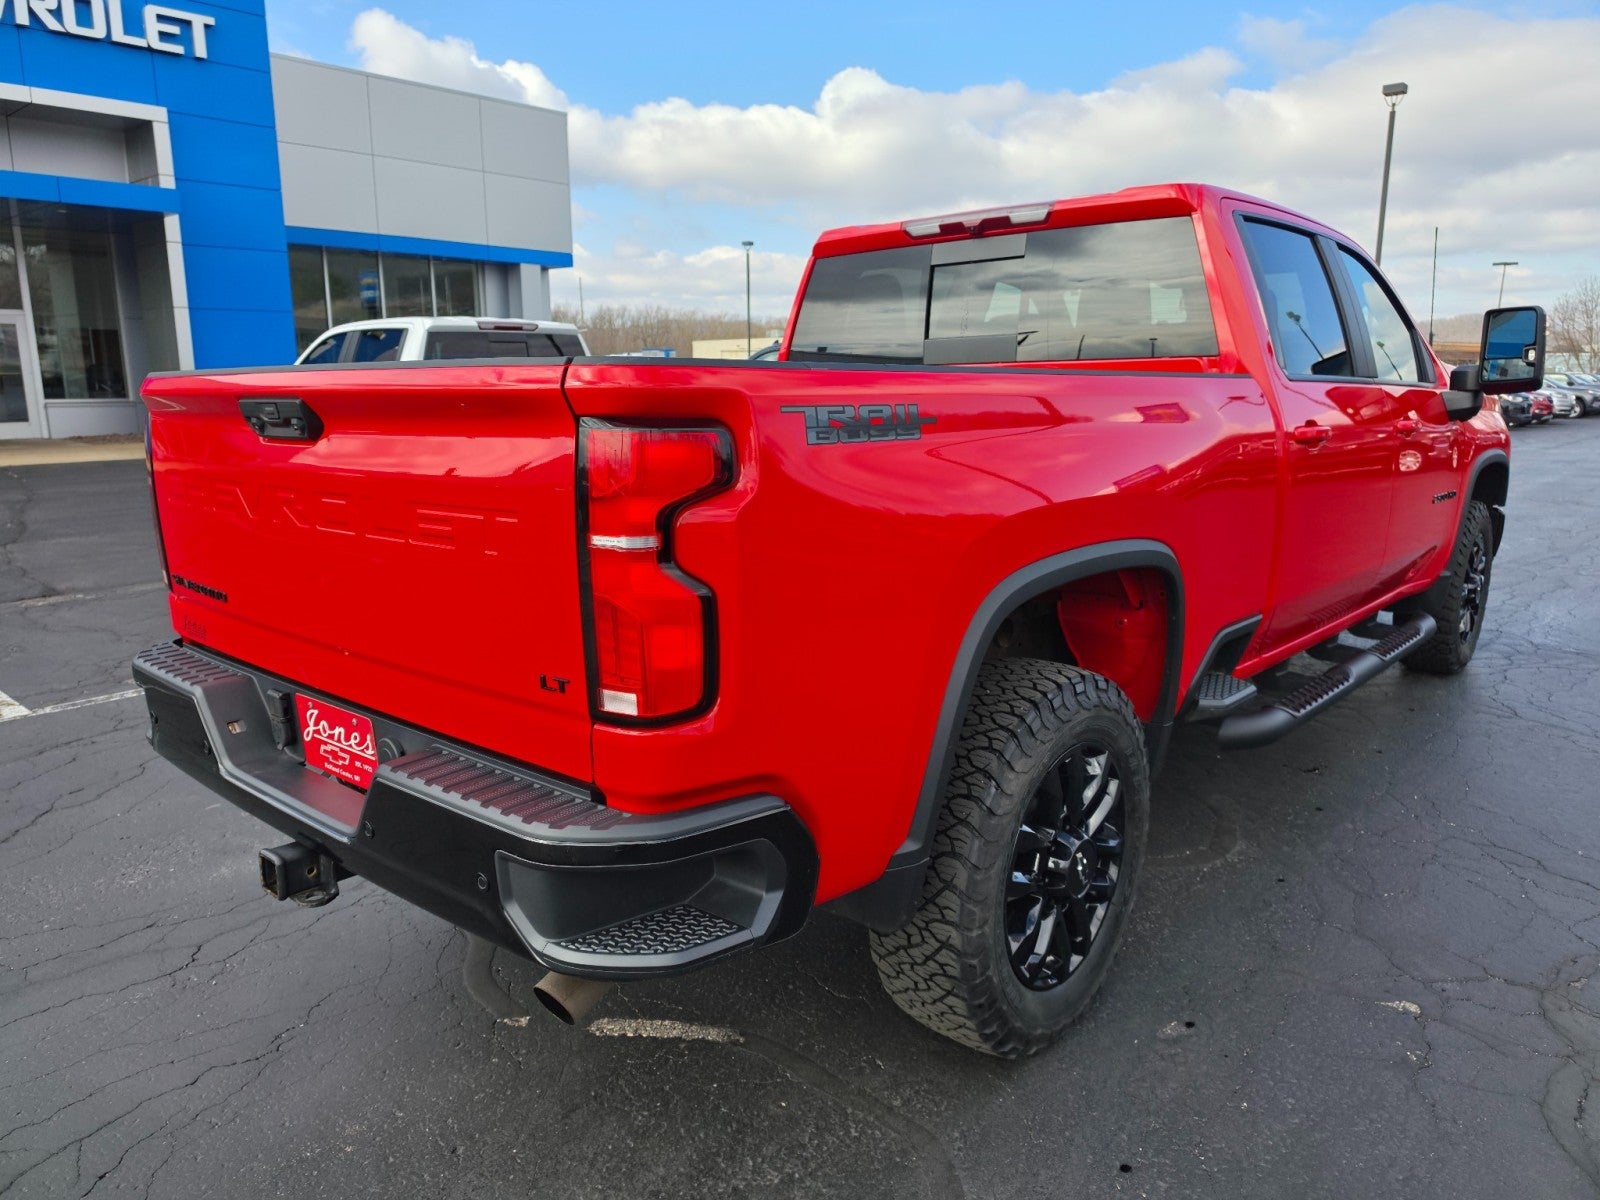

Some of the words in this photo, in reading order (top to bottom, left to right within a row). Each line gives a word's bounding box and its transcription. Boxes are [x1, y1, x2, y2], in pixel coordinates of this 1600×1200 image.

[0, 0, 215, 59] ROLET
[807, 426, 921, 445] BOSS
[540, 673, 571, 694] LT
[304, 709, 375, 755] Jones
